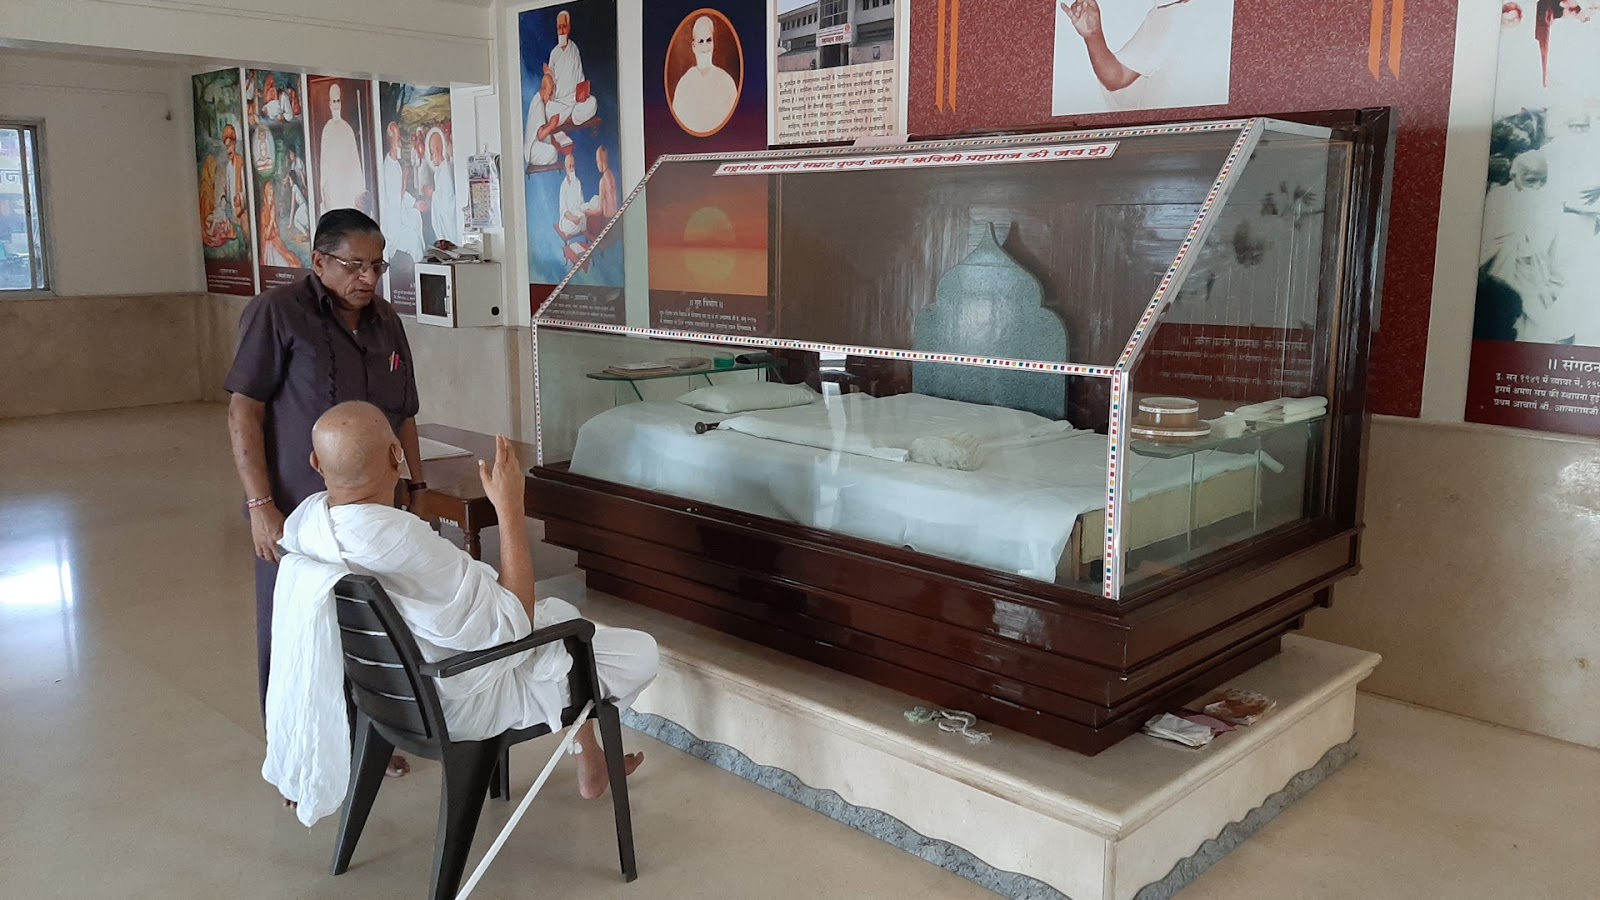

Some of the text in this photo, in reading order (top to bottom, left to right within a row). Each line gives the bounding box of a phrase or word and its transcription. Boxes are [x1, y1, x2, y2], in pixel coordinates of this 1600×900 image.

[761, 162, 800, 170] आचार्य
[803, 160, 834, 168] सम्राट
[837, 159, 866, 170] पूज्य
[870, 157, 908, 166] आनंद
[966, 152, 1022, 162] महाराज
[1027, 150, 1050, 158] की
[1054, 149, 1084, 158] जय
[1514, 387, 1532, 396] श्रमण
[1548, 388, 1559, 398] की
[1561, 391, 1588, 401] स्थापना
[1494, 398, 1510, 407] प्रथम
[1513, 400, 1538, 410] आचार्य
